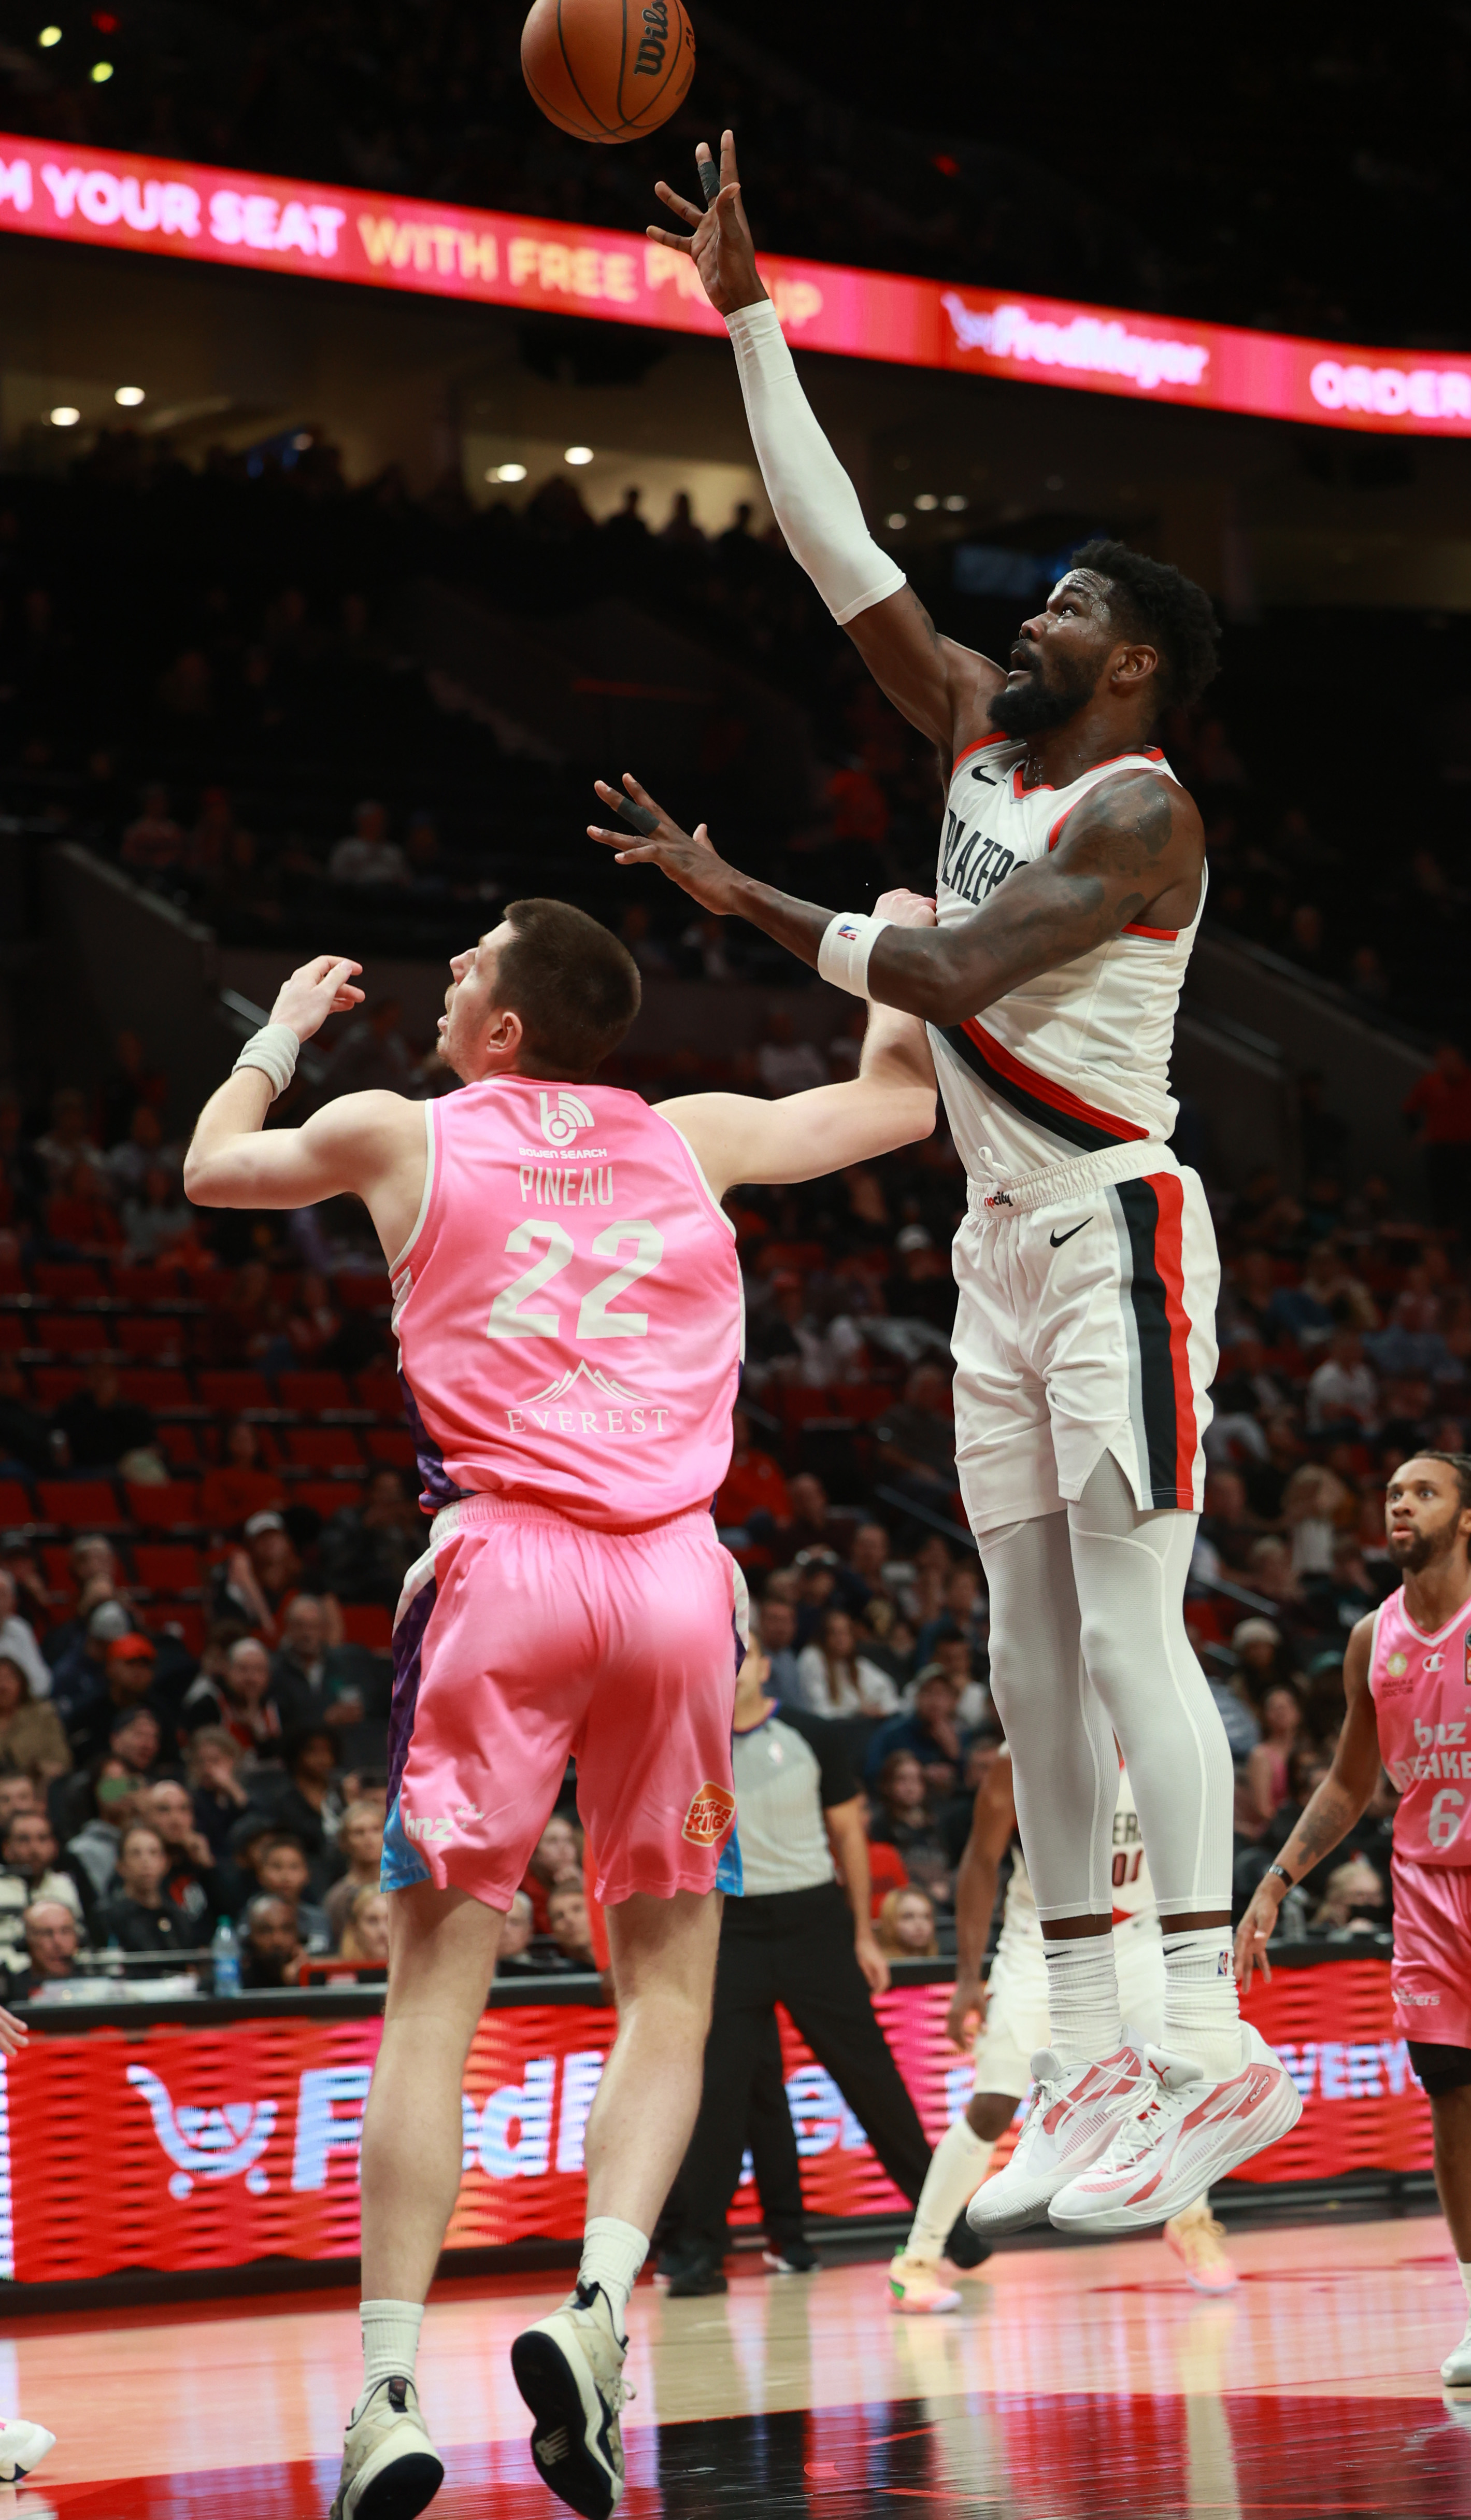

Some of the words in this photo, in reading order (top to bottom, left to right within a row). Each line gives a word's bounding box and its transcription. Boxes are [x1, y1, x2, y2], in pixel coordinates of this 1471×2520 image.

[41, 162, 201, 238] YOUR
[210, 190, 347, 258] SEAT
[357, 213, 498, 283] WITH
[508, 237, 639, 304] FREE
[1309, 360, 1471, 419] ORDER
[941, 807, 1030, 906] BLAZER
[518, 1146, 559, 1159] BOWEN
[560, 1148, 608, 1159] SEARCH
[519, 1165, 613, 1206] PINEAU
[487, 1219, 665, 1339] 22
[505, 1408, 669, 1435] EVEREST
[1427, 1788, 1464, 1848] 6
